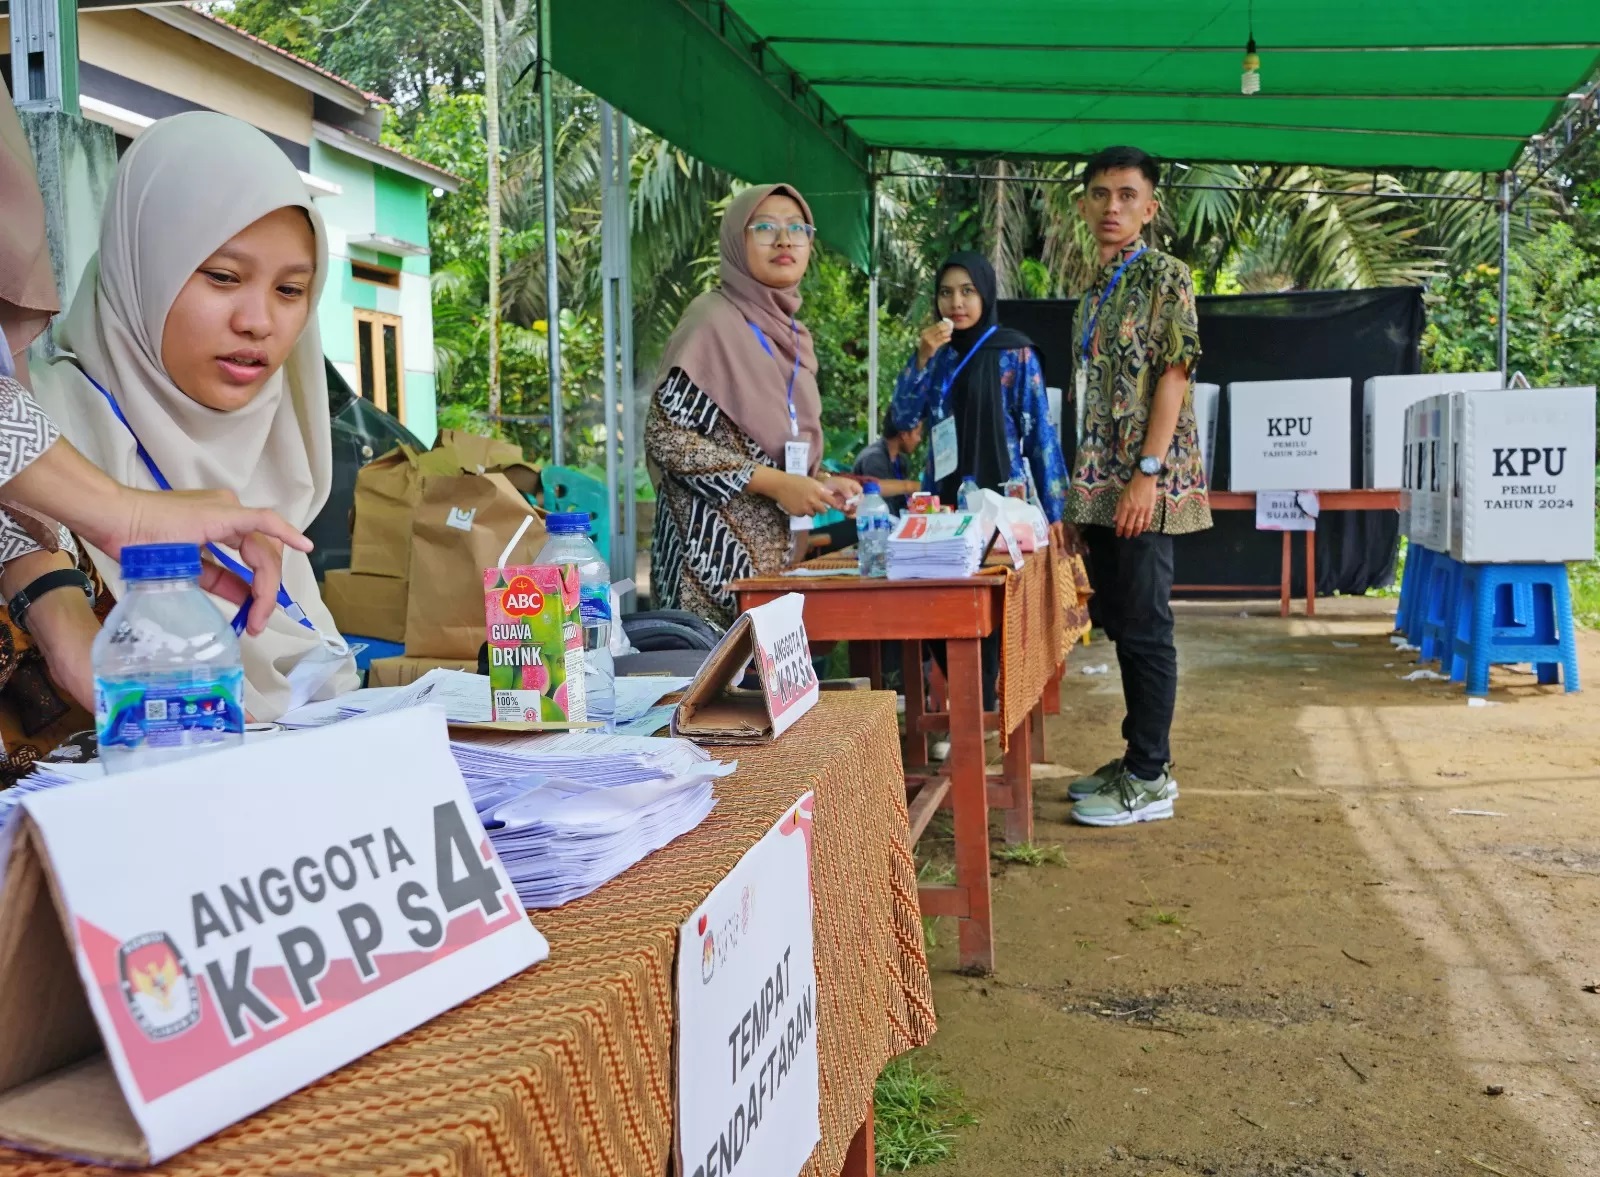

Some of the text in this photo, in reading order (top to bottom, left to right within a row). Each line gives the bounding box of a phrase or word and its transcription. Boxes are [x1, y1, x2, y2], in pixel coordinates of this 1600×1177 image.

[1267, 417, 1312, 437] KPU
[1492, 447, 1567, 477] KPU
[1501, 485, 1556, 495] PEMILU
[1484, 499, 1574, 509] TAHUN 2024
[506, 593, 541, 609] ABC
[491, 624, 532, 640] GUAVA
[492, 646, 543, 667] DRINK
[774, 630, 802, 664] ANGGOTA
[778, 656, 807, 704] KPPS
[497, 696, 519, 706] 100%
[190, 800, 504, 948] ANGGOTA 4
[205, 881, 444, 1041] KPPS
[729, 945, 791, 1086] TEMPAT
